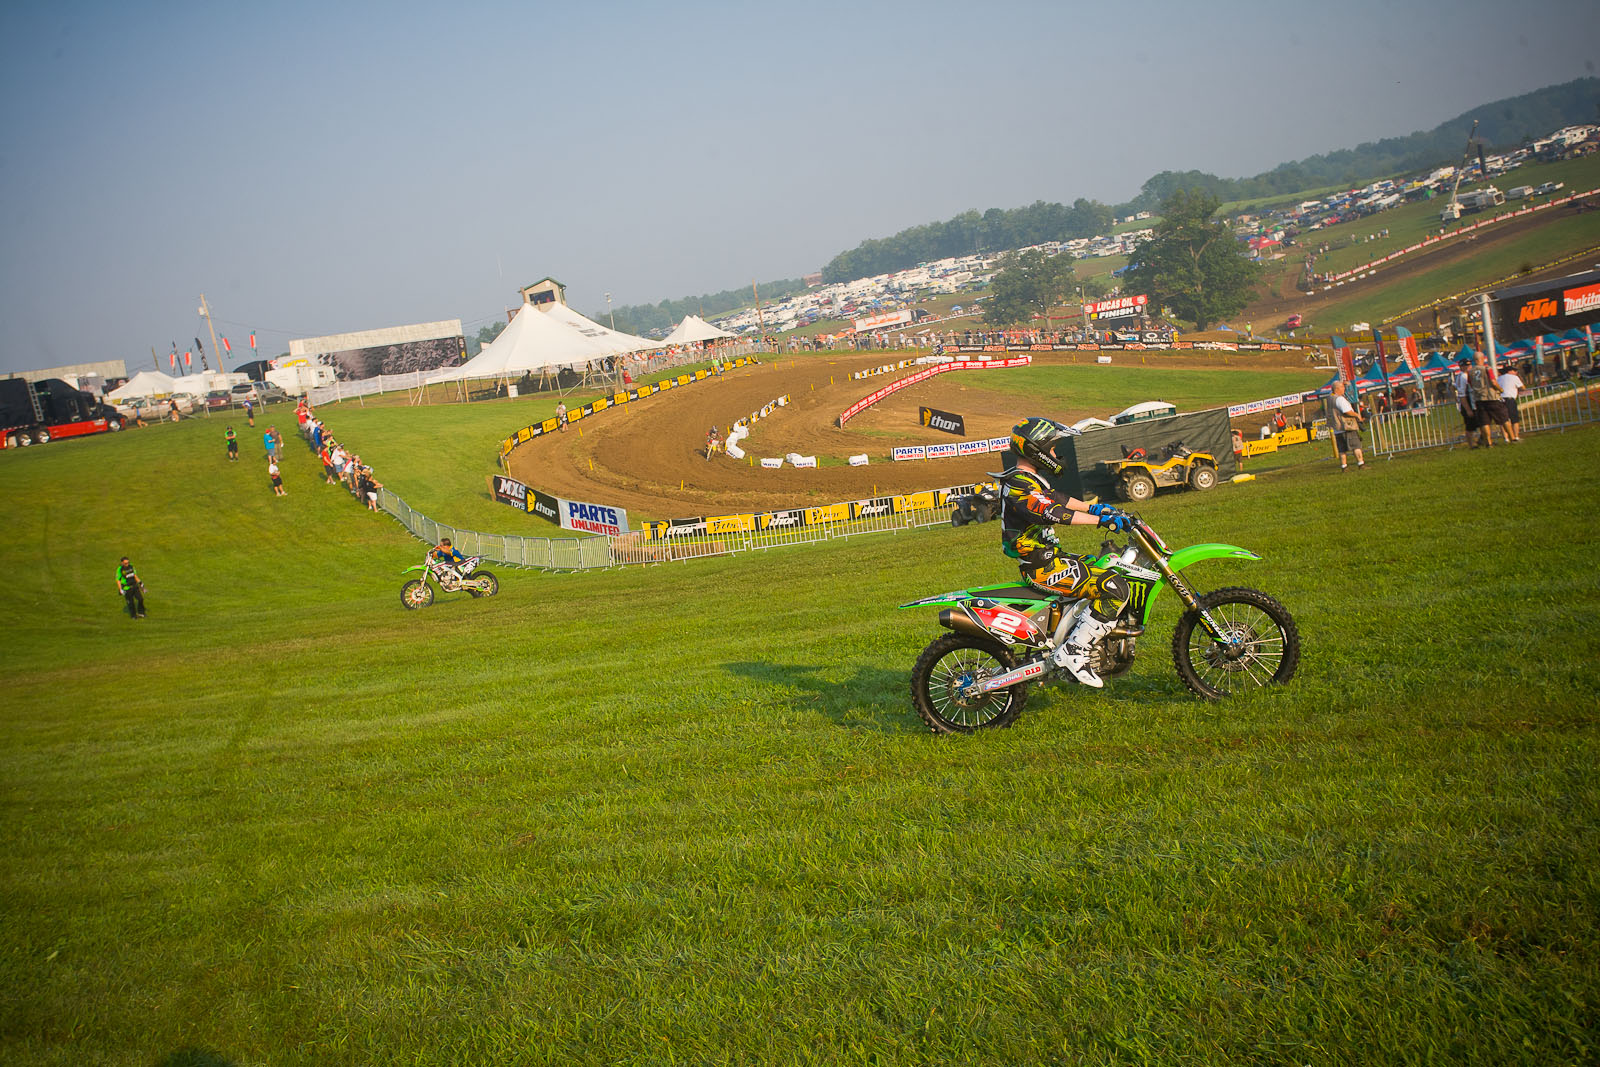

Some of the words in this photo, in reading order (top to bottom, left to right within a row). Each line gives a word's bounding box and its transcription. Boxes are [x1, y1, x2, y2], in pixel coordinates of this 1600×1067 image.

[1096, 299, 1121, 312] LUCAS
[1121, 297, 1134, 307] OIL
[1098, 306, 1135, 319] FINISH
[1518, 298, 1558, 323] KTM
[930, 415, 960, 431] thor
[959, 441, 987, 450] PARTS
[990, 438, 1010, 446] PART
[498, 478, 526, 500] MXS
[510, 499, 526, 510] TOYS
[535, 501, 556, 517] thor
[862, 504, 889, 515] thor
[568, 502, 618, 526] PARTS
[768, 516, 799, 527] thor
[570, 518, 620, 537] UNLIMITED
[1167, 574, 1190, 597] KYB
[991, 612, 1022, 634] 2
